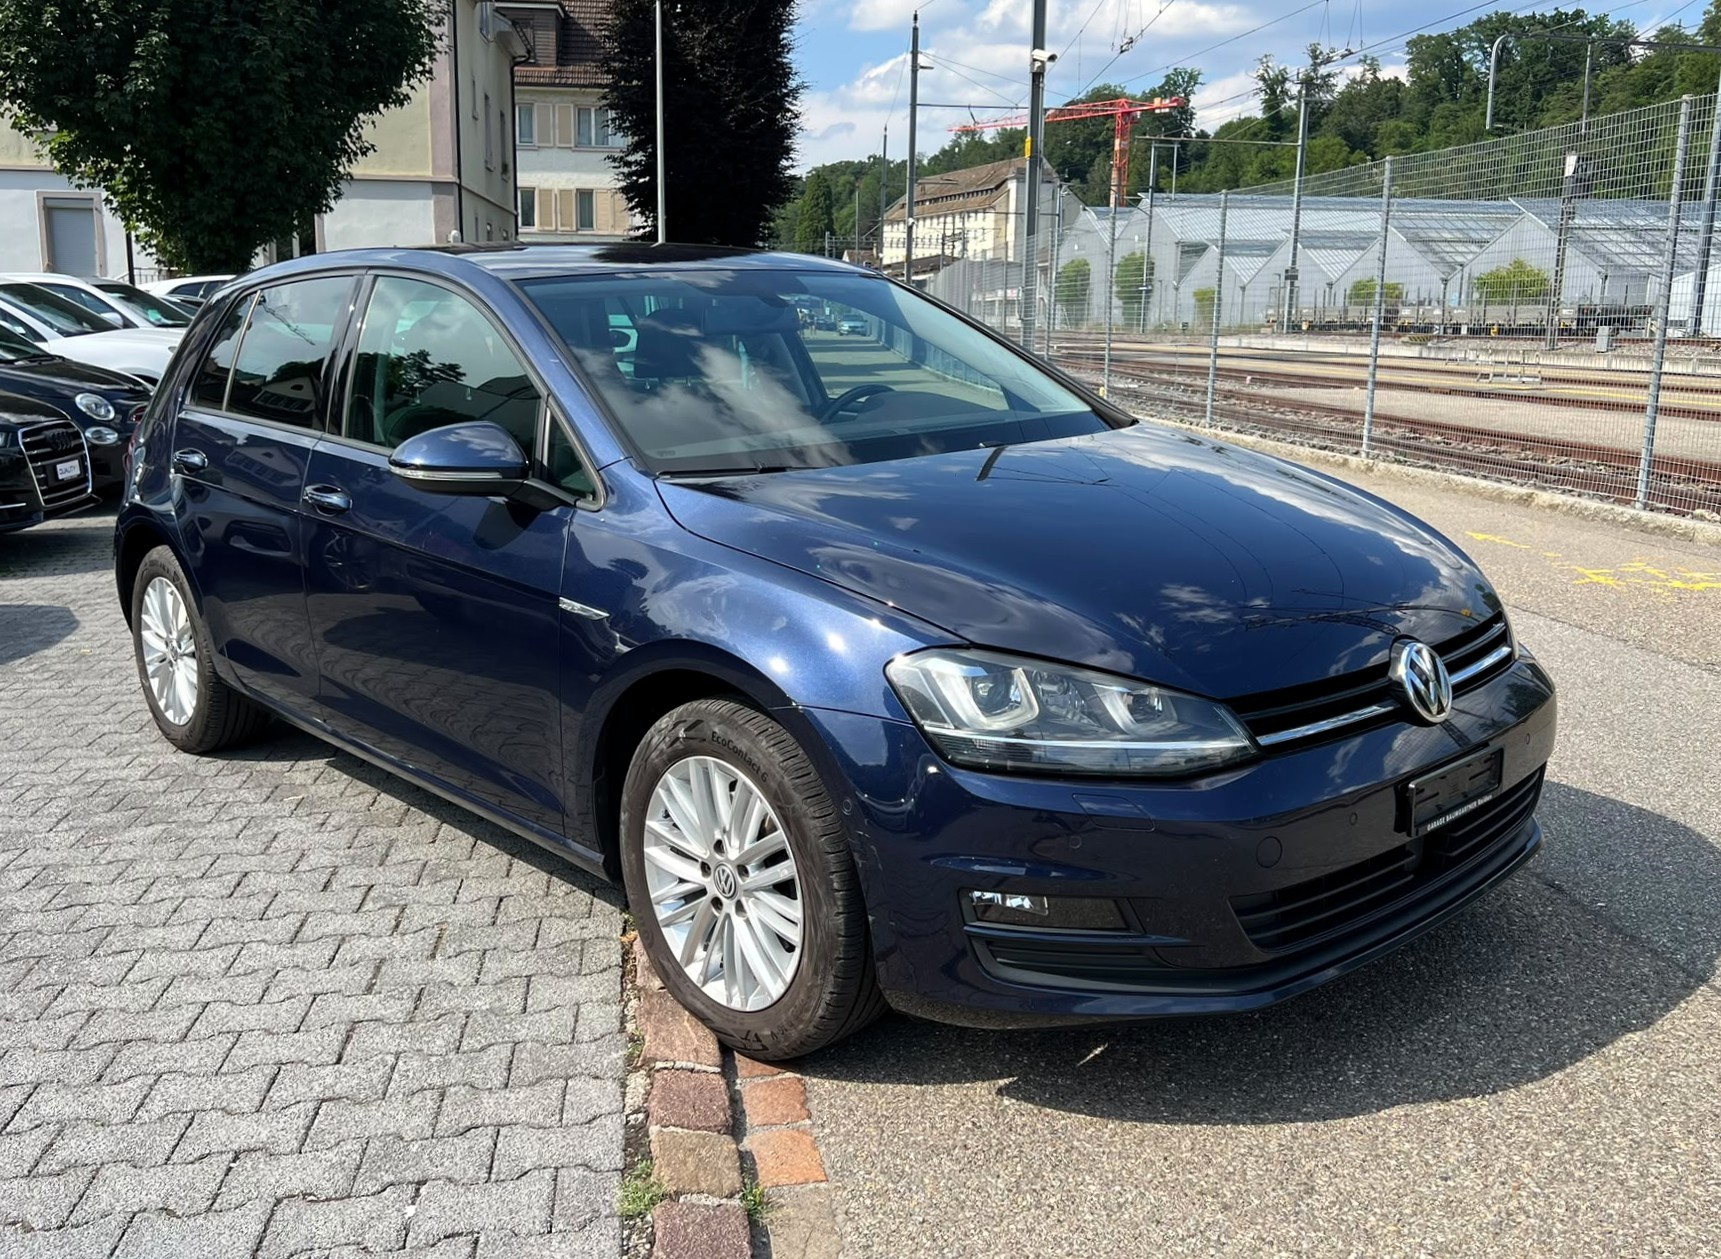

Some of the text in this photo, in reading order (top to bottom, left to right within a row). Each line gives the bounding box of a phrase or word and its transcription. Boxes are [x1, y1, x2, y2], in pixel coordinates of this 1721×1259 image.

[711, 730, 769, 782] EcoContact 6
[1427, 816, 1445, 831] GARAGE
[1446, 800, 1477, 822] BAUMGARTNER
